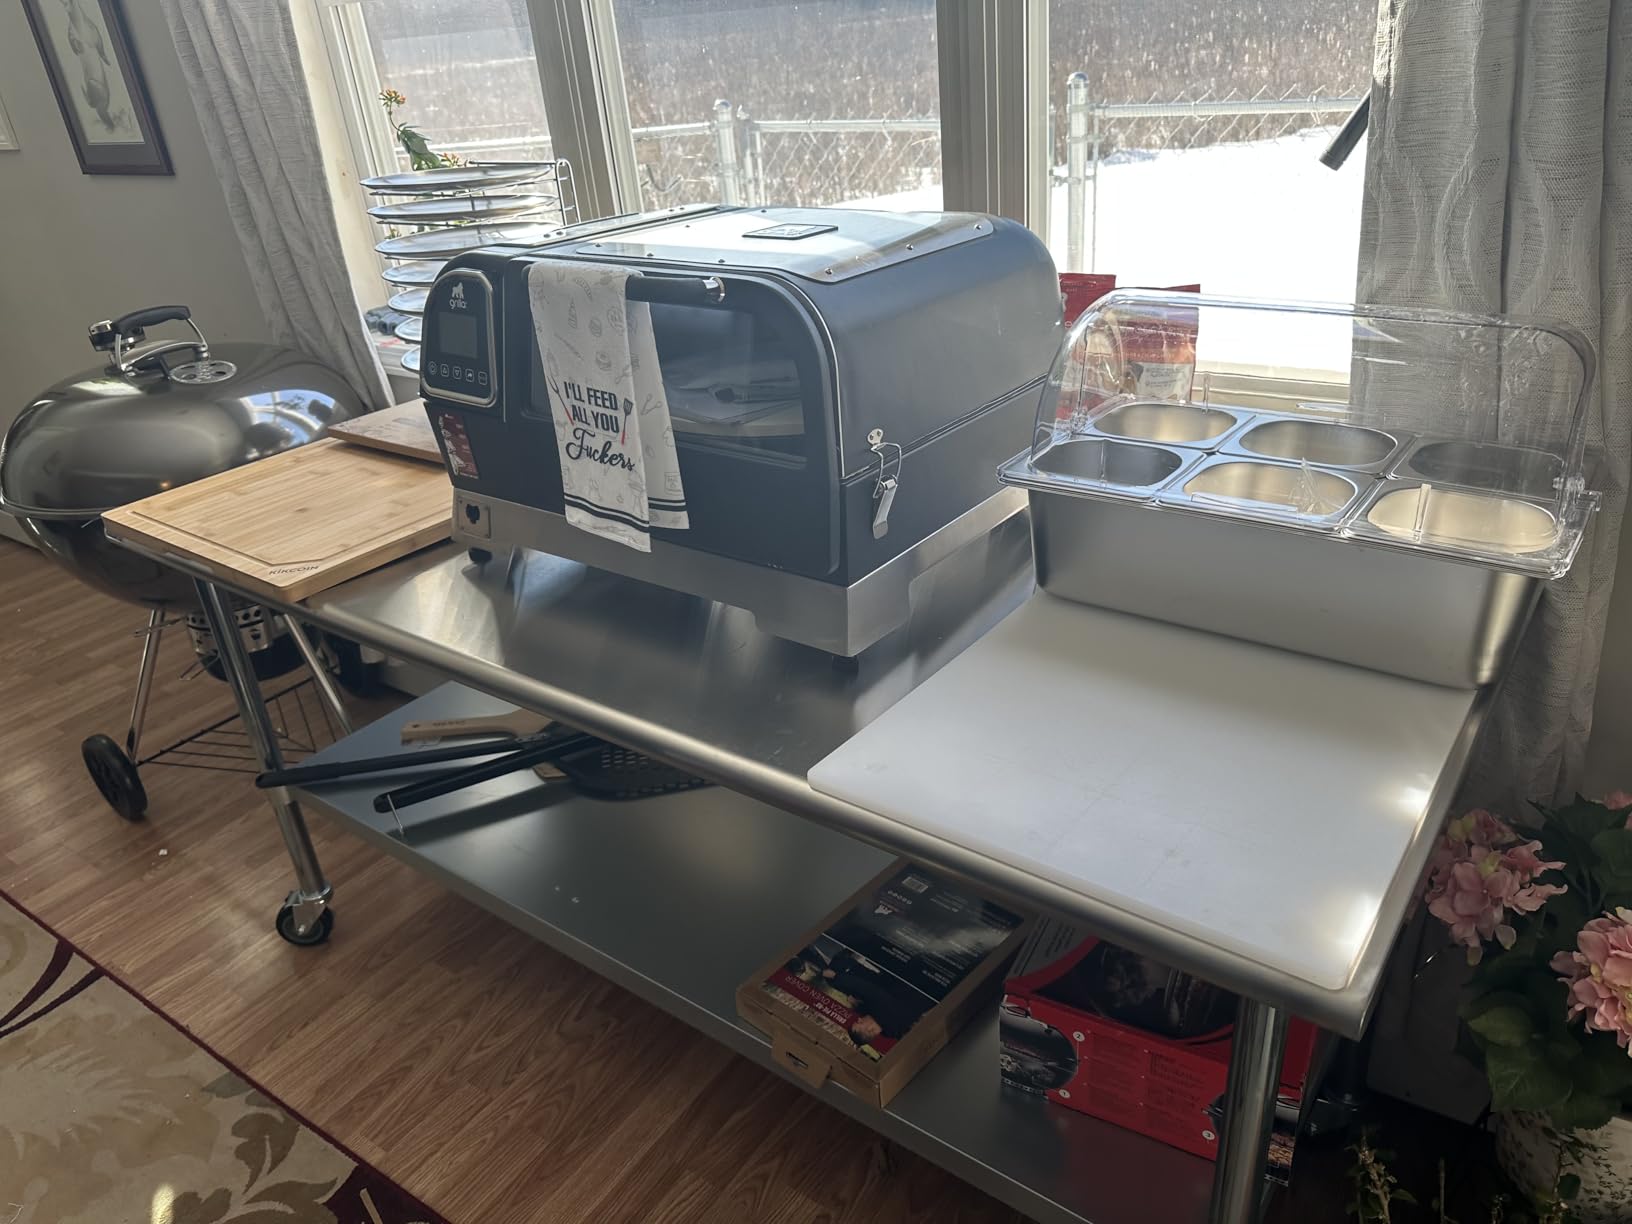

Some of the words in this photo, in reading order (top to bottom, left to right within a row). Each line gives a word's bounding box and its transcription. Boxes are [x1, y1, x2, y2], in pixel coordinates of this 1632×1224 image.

[564, 381, 585, 403] I'LL
[586, 386, 618, 410] FEED
[572, 405, 590, 426] ALL
[591, 411, 620, 433] YOU
[565, 427, 636, 472] Fuckers
[785, 975, 810, 992] COVER
[809, 989, 830, 1005] OVEN
[830, 1002, 851, 1019] PIZZA
